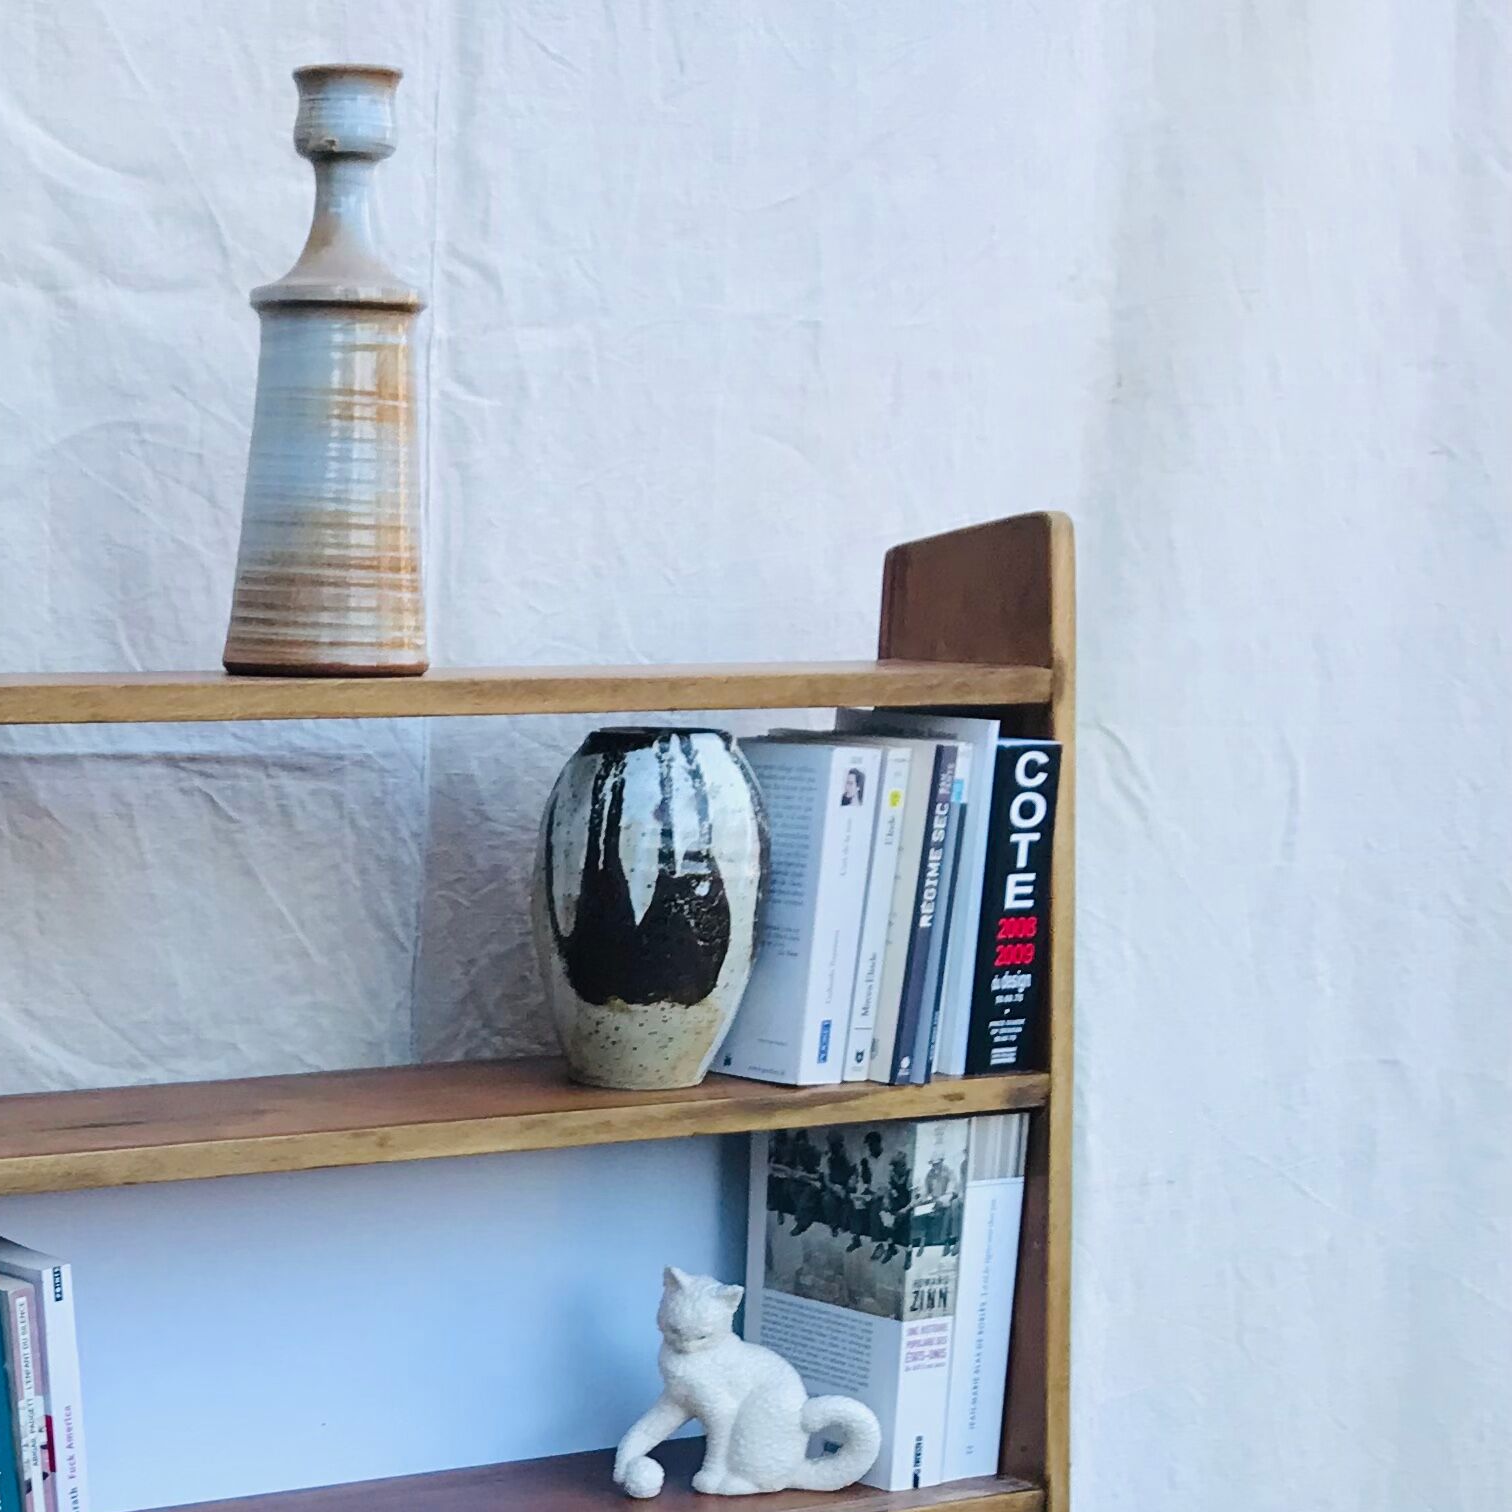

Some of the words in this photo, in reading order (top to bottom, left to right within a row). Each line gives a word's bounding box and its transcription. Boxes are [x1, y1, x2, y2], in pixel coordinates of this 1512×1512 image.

[932, 802, 950, 842] SEC
[1004, 750, 1050, 910] COTE
[994, 943, 1036, 967] 2009
[910, 1287, 948, 1312] ZINN
[64, 1405, 74, 1449] America
[67, 1454, 76, 1479] Fuck
